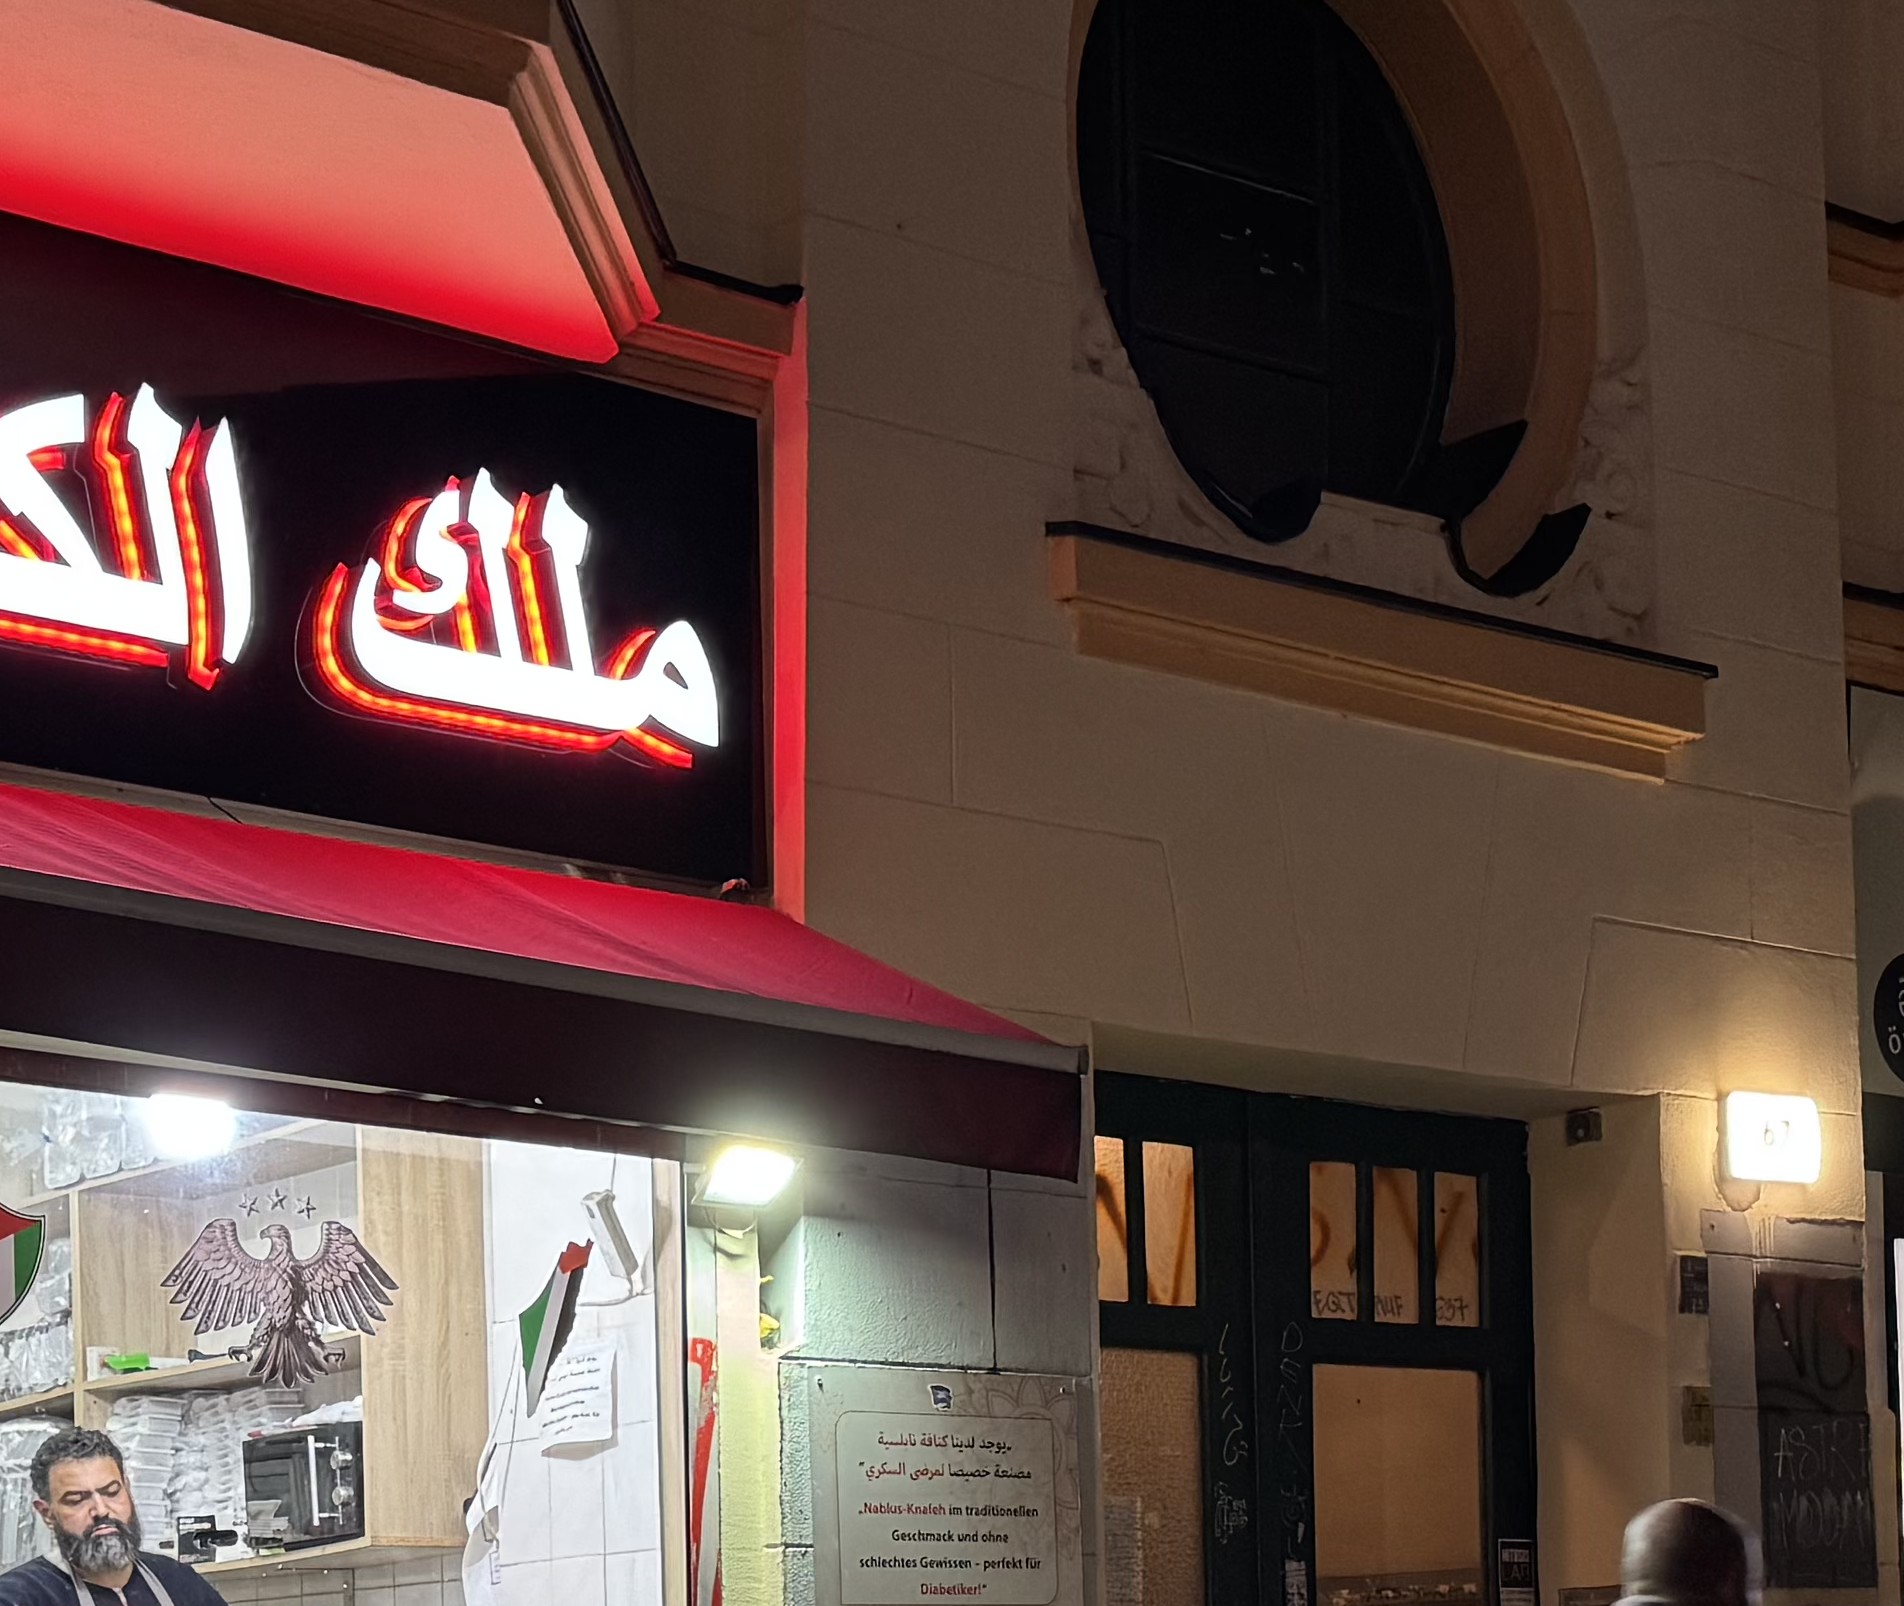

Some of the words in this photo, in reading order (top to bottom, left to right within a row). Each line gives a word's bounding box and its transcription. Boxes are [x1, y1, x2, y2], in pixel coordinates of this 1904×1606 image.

[348, 466, 721, 750] ملك
[1762, 1118, 1791, 1147] 67
[920, 1432, 949, 1449] كنافة
[948, 1503, 963, 1516] im
[965, 1503, 1039, 1518] traditionellen
[891, 1528, 955, 1543] Geschmack
[957, 1529, 979, 1543] und
[981, 1529, 1009, 1543] ohne
[859, 1555, 918, 1569] schlechtes
[919, 1556, 972, 1569] Gewissen
[982, 1556, 1024, 1572] perfekt
[1025, 1556, 1042, 1570] für
